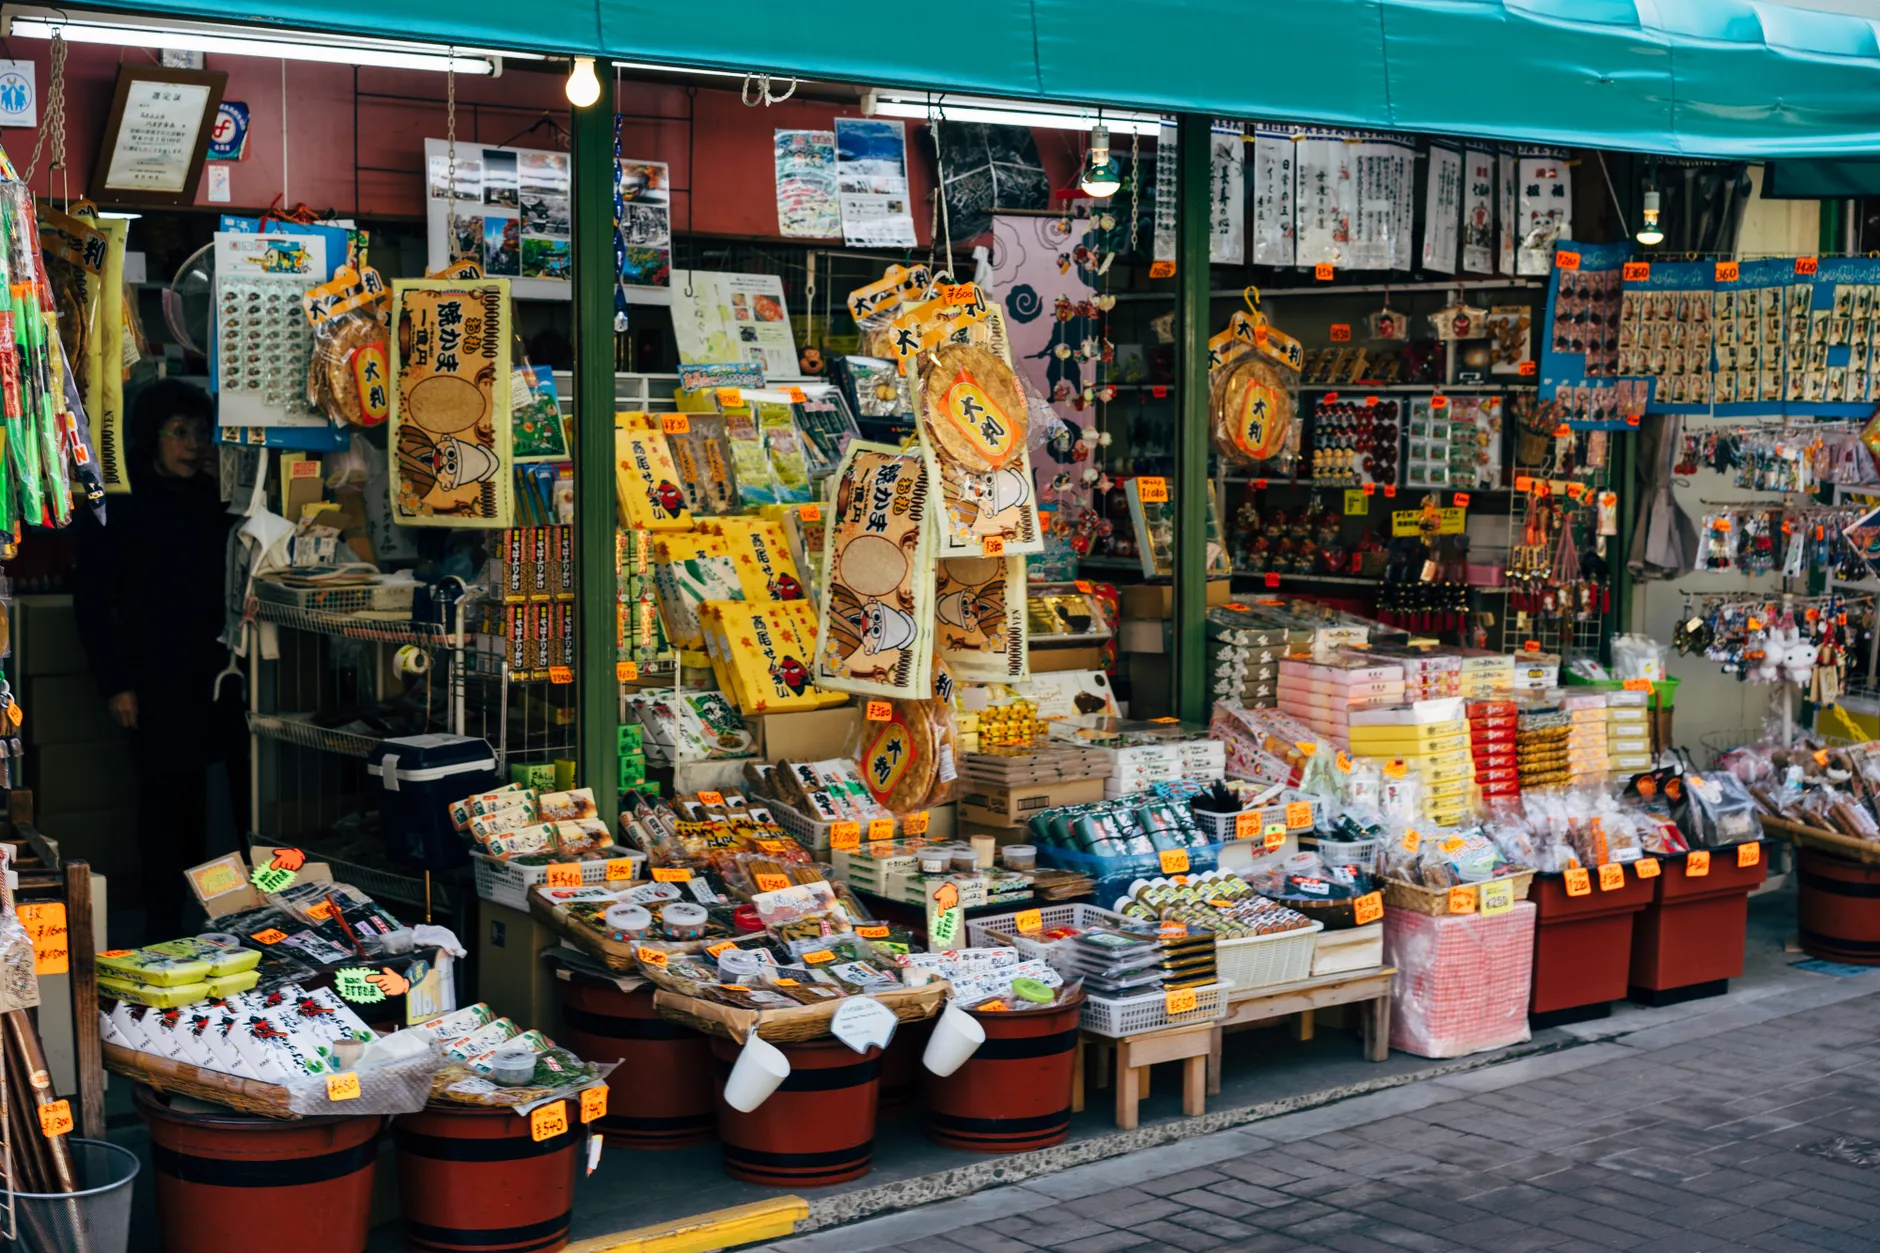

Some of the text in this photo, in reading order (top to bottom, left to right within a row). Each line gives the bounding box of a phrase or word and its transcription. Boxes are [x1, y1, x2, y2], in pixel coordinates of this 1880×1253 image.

[946, 287, 973, 303] ¥600
[415, 308, 429, 366] 一億円
[434, 301, 463, 373] 焼かま
[462, 317, 481, 355] お札
[103, 410, 114, 429] YEN
[664, 419, 687, 430] ¥830
[960, 395, 1006, 446] 大判
[1247, 397, 1266, 444] 大判
[850, 467, 871, 523] 一億円
[865, 462, 902, 533] 焼かま
[892, 477, 913, 515] お札
[1011, 608, 1021, 626] YEN
[551, 874, 581, 887] ¥540
[759, 878, 788, 890] ¥540
[411, 988, 439, 1018] No.
[536, 1118, 564, 1137] ¥540
